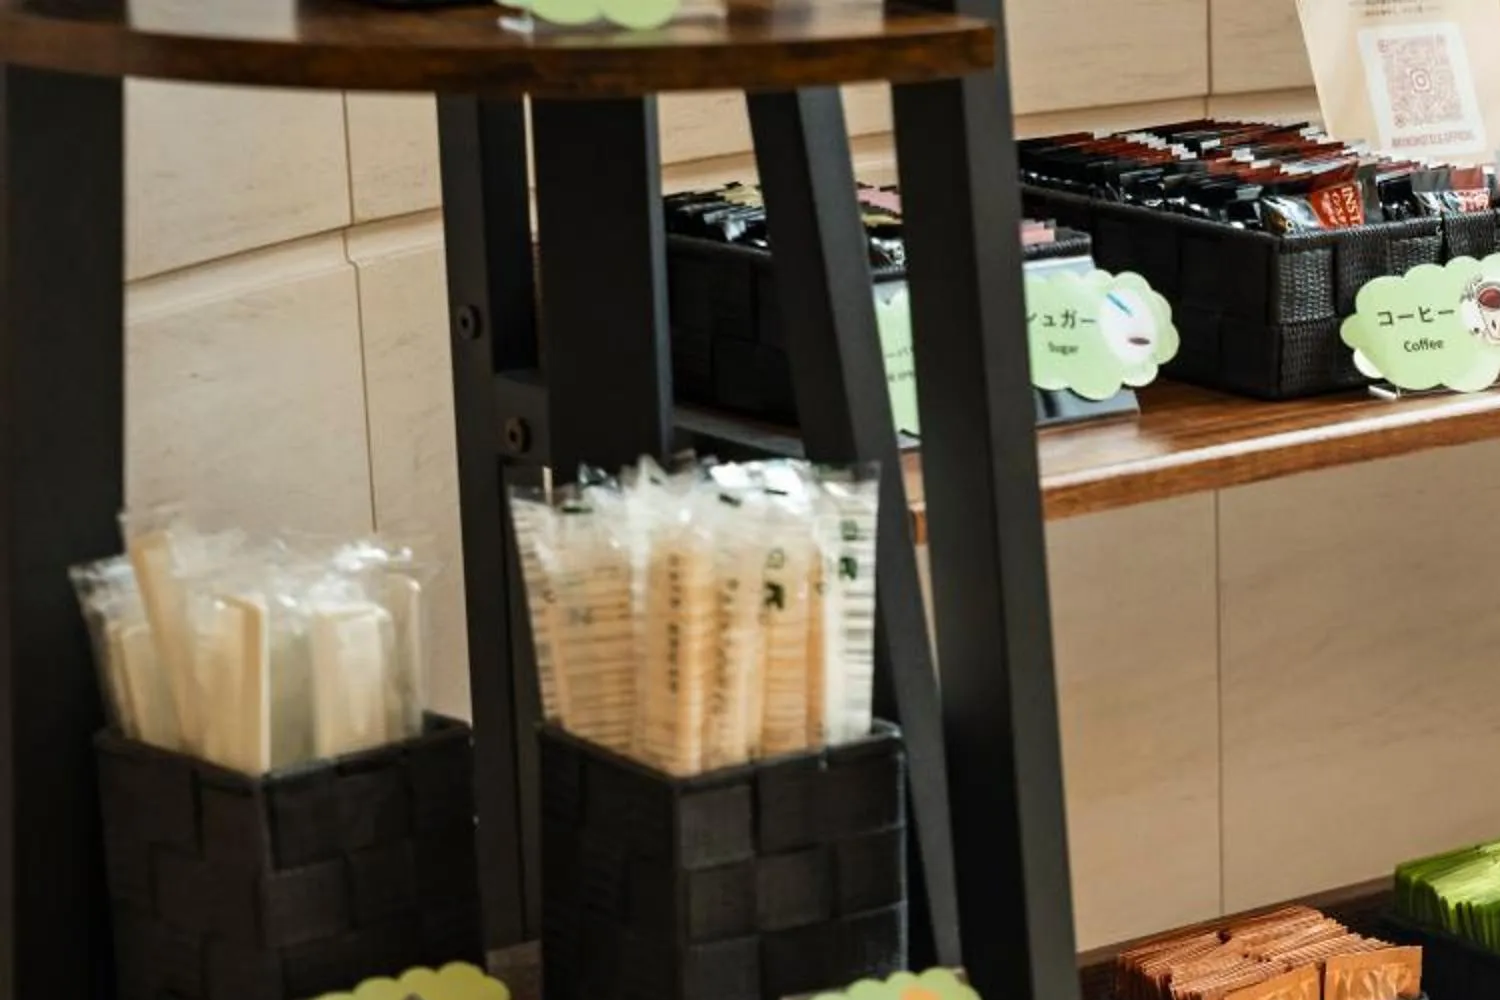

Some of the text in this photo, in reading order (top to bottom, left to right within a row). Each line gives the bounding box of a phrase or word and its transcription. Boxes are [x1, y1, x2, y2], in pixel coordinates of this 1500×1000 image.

[1376, 304, 1456, 328] コーヒー
[1403, 337, 1445, 353] Coffee
